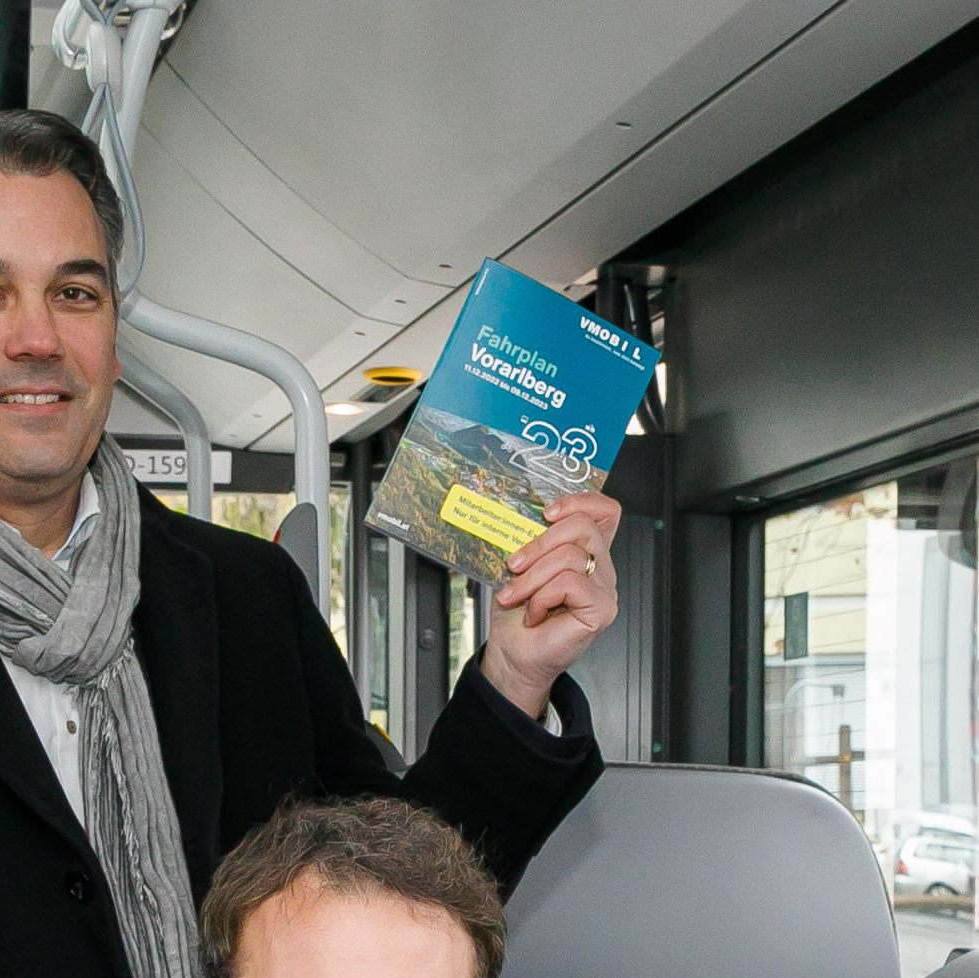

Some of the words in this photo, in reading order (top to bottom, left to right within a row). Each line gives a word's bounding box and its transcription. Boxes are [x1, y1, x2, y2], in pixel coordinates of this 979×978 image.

[471, 342, 567, 409] Vorarlberg
[477, 324, 558, 378] Fahrplan
[509, 420, 598, 491] 23
[453, 506, 468, 520] Nur
[469, 514, 480, 525] für
[482, 521, 510, 539] interne
